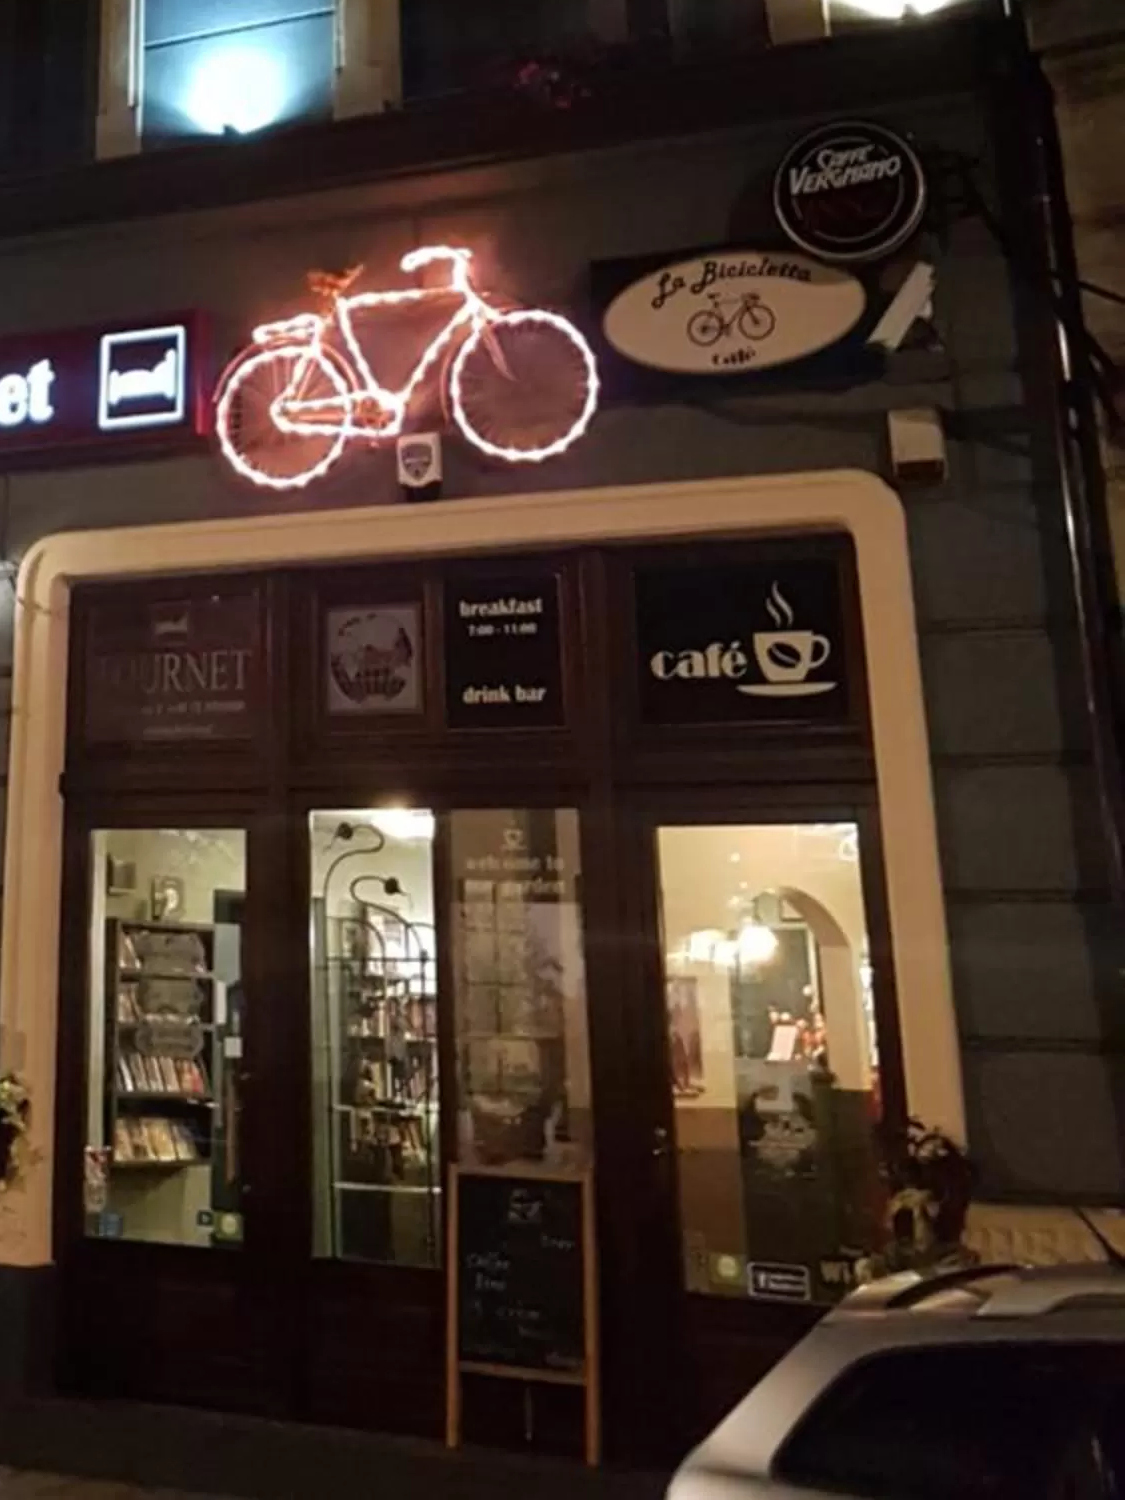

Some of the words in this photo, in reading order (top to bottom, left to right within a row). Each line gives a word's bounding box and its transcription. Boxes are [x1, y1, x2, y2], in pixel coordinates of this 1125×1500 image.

[651, 272, 686, 309] La
[690, 257, 812, 294] Bicicletta
[459, 597, 543, 617] breakfast
[651, 639, 746, 681] café
[462, 684, 511, 704] drink
[515, 684, 547, 702] bar
